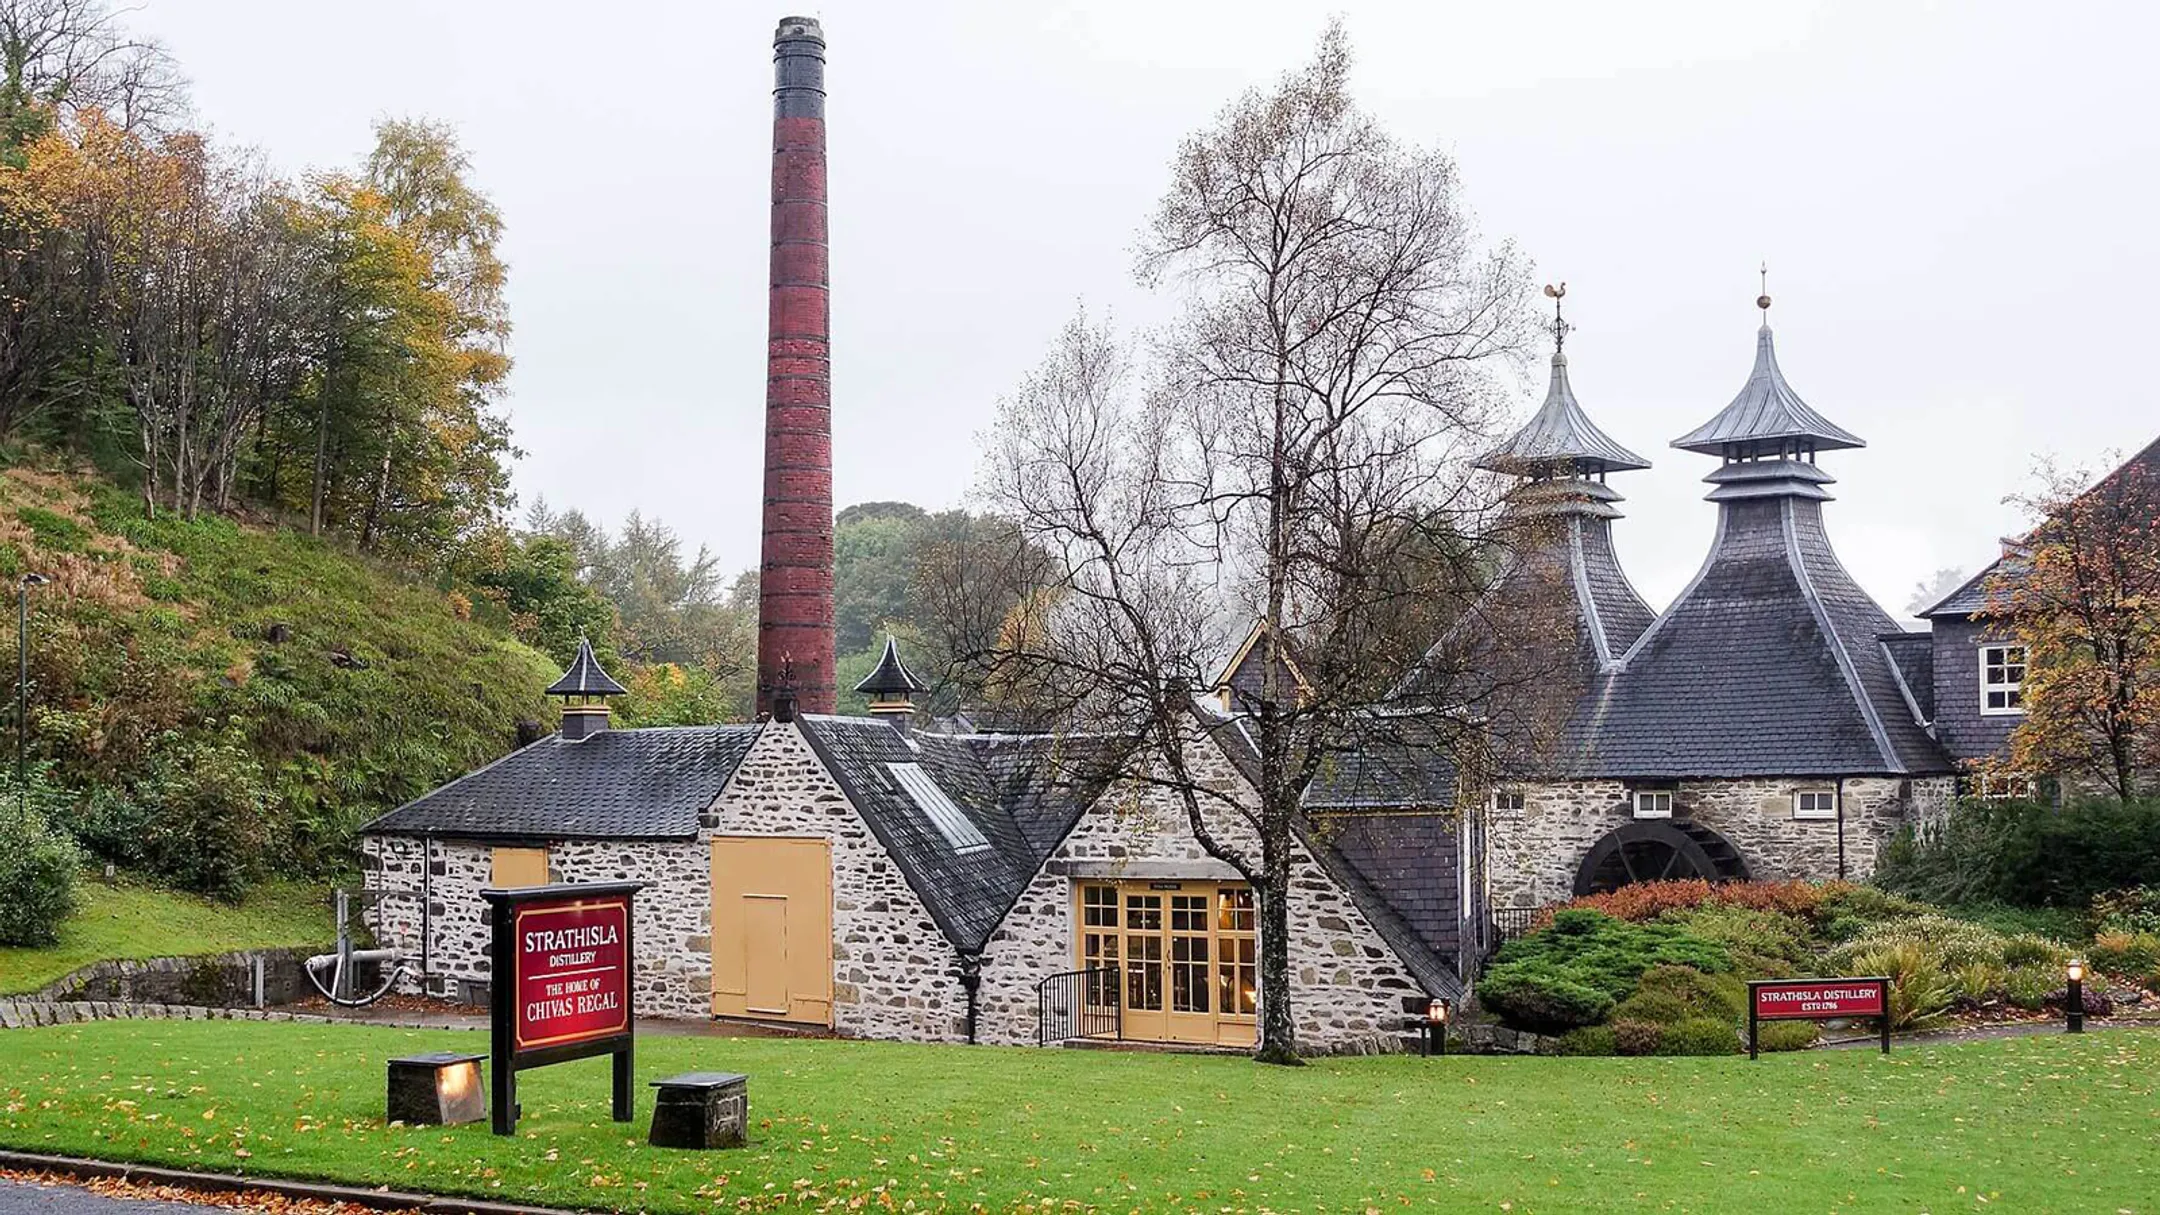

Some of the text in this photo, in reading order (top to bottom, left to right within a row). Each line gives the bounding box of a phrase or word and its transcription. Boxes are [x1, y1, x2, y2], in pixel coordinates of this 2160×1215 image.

[525, 925, 618, 953] STRATHISLA
[549, 951, 596, 967] DISTILLERY
[546, 978, 601, 996] THE HOME OF
[1761, 989, 1877, 1002] STRATHISLA DISTILLERY
[527, 992, 618, 1022] CHIVAS REGAL
